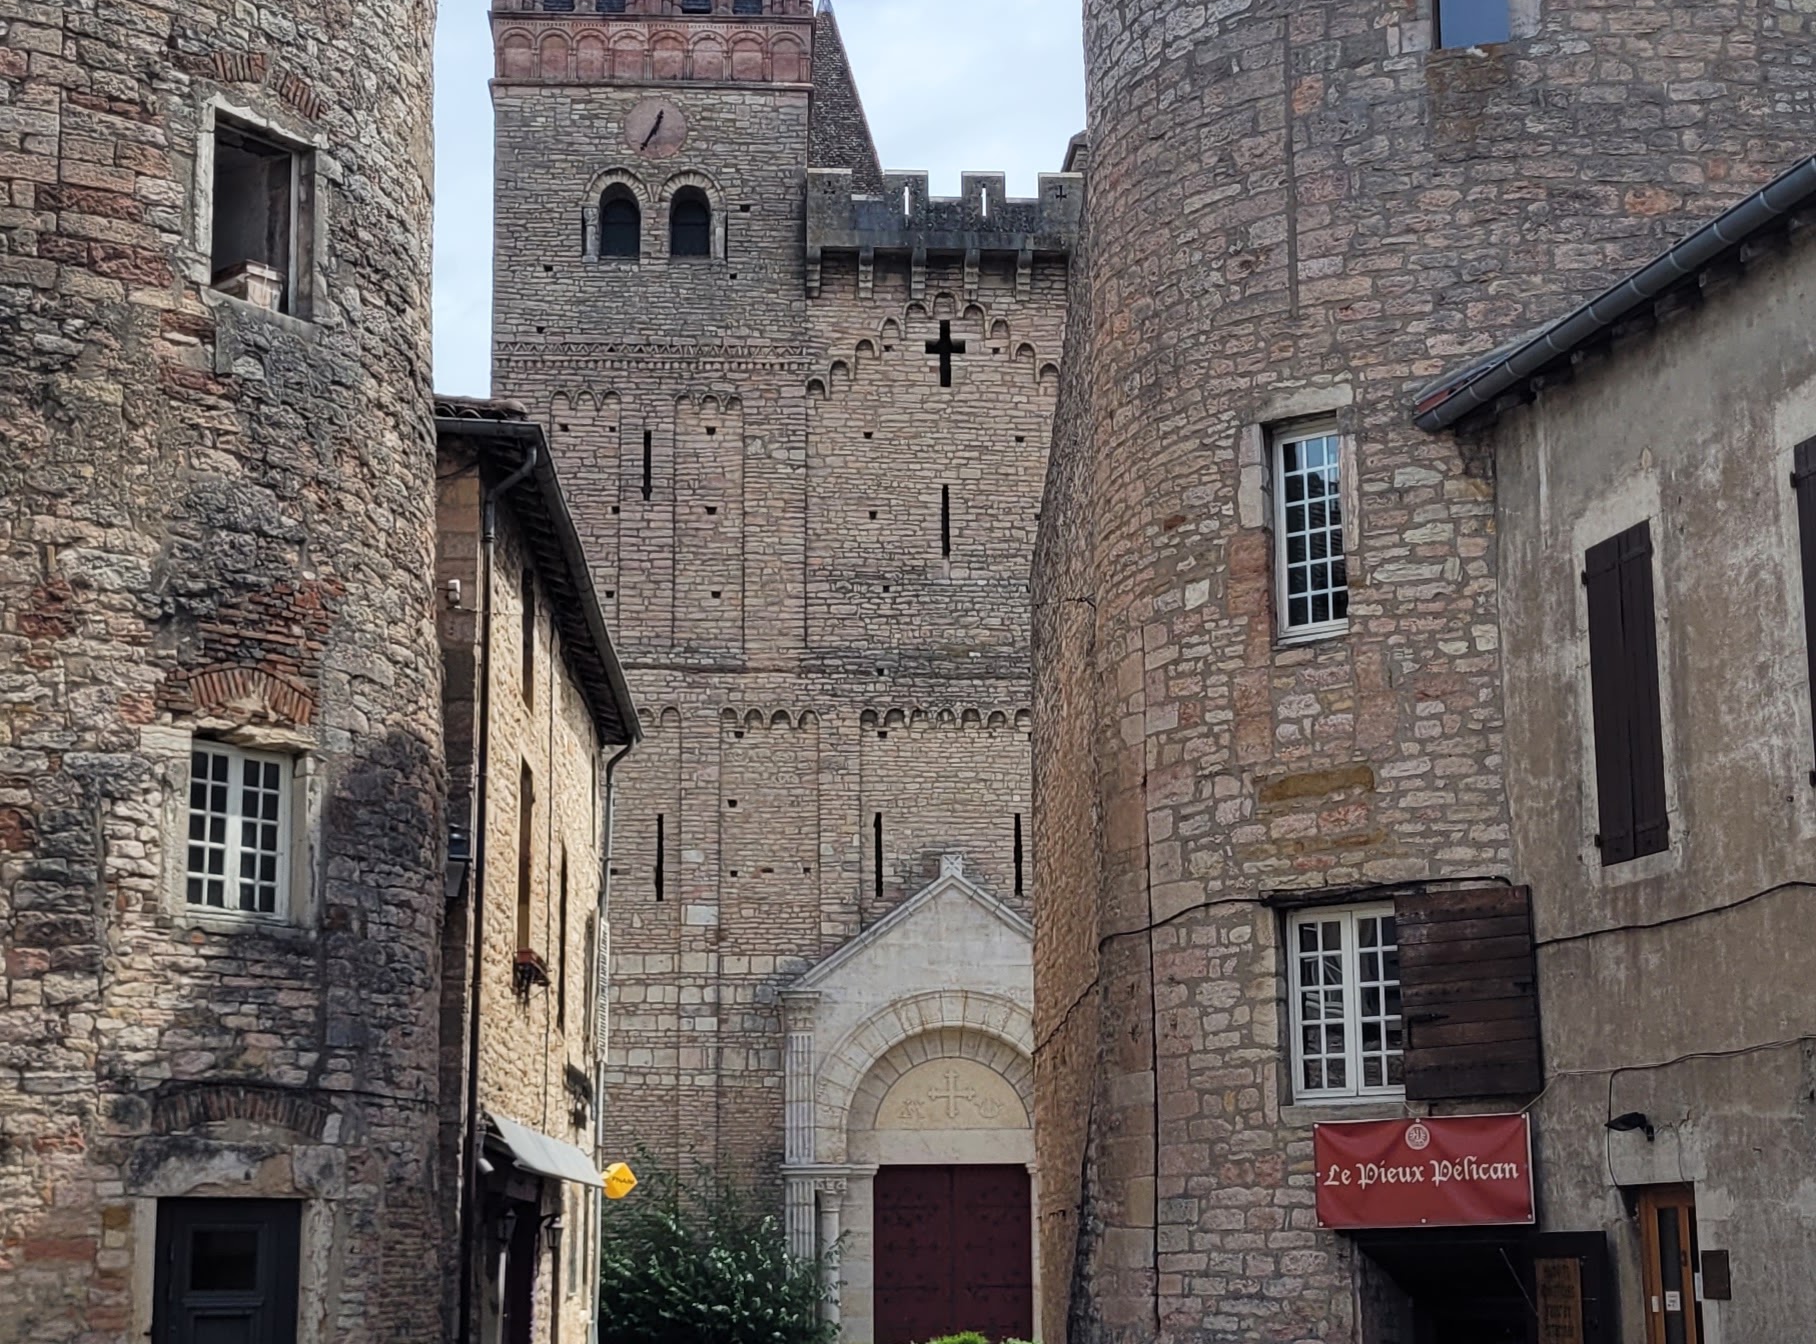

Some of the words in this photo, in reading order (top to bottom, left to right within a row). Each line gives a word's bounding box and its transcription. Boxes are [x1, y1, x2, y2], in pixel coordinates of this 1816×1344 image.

[1323, 1164, 1352, 1186] Le
[1356, 1161, 1425, 1189] Pieux
[1430, 1156, 1519, 1187] Pélican
